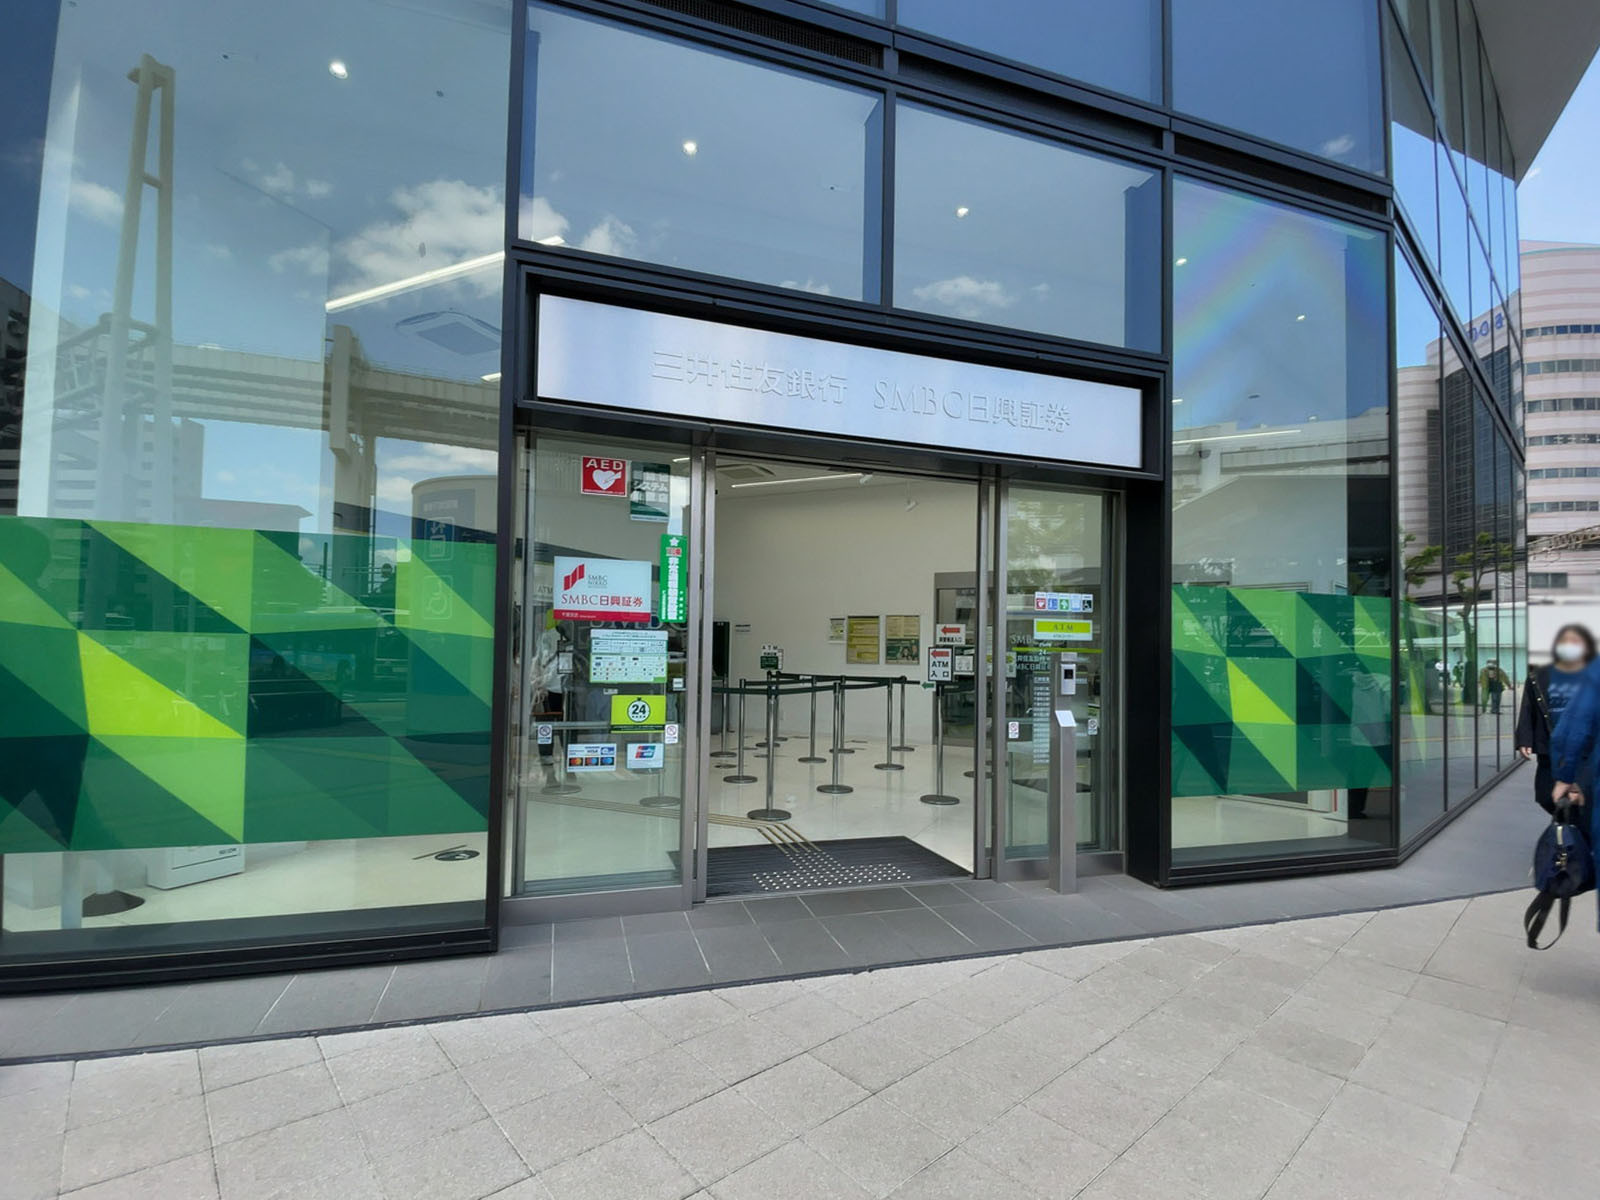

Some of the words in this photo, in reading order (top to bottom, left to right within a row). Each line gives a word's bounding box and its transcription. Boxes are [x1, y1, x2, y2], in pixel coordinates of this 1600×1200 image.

[651, 351, 848, 405] 三井住友銀行
[872, 380, 1071, 433] SMBC日興証券
[586, 458, 623, 470] AED
[561, 593, 643, 607] SMBC日興証券
[930, 670, 950, 678] 入口
[632, 704, 646, 715] 24
